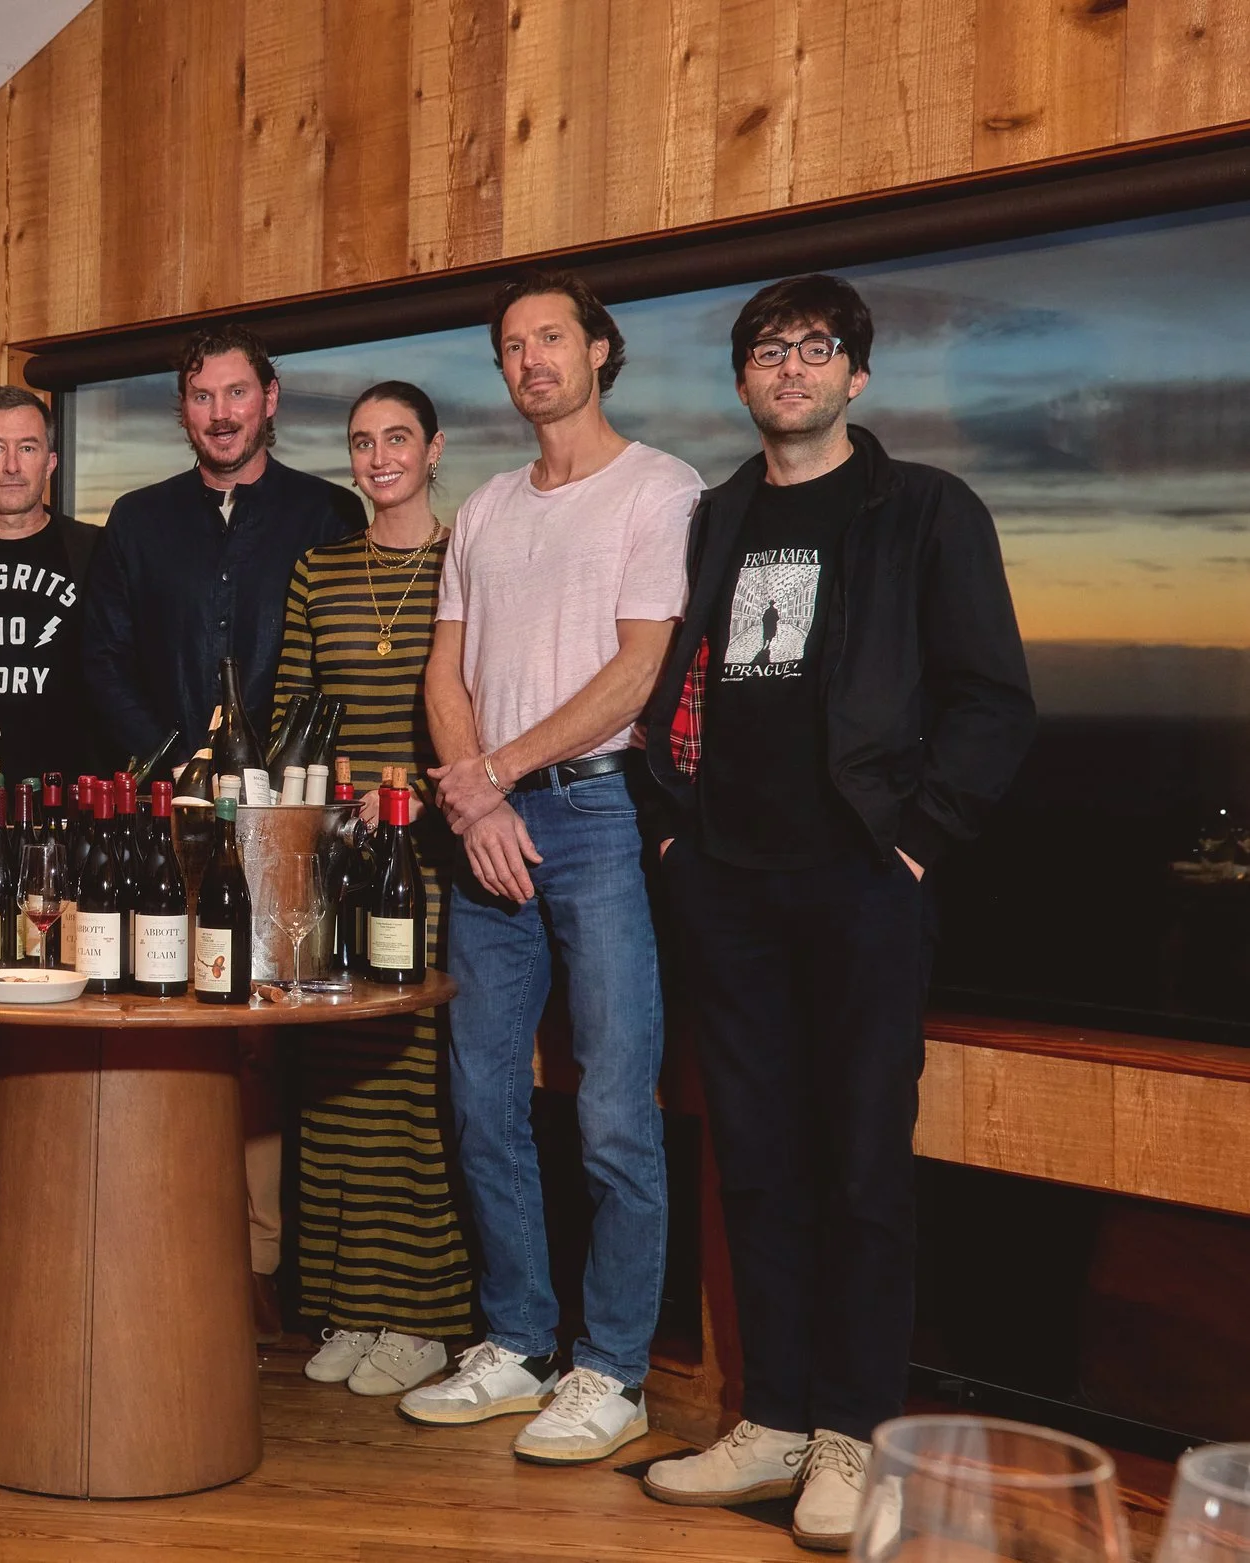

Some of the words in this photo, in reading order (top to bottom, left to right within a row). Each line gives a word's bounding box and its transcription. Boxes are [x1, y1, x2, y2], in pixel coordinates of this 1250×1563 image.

[743, 550, 778, 567] FRANZ
[779, 548, 819, 564] KAFKA
[729, 661, 795, 677] PRAGUE
[143, 928, 180, 936] ABBOTT
[147, 951, 176, 959] CLAIM
